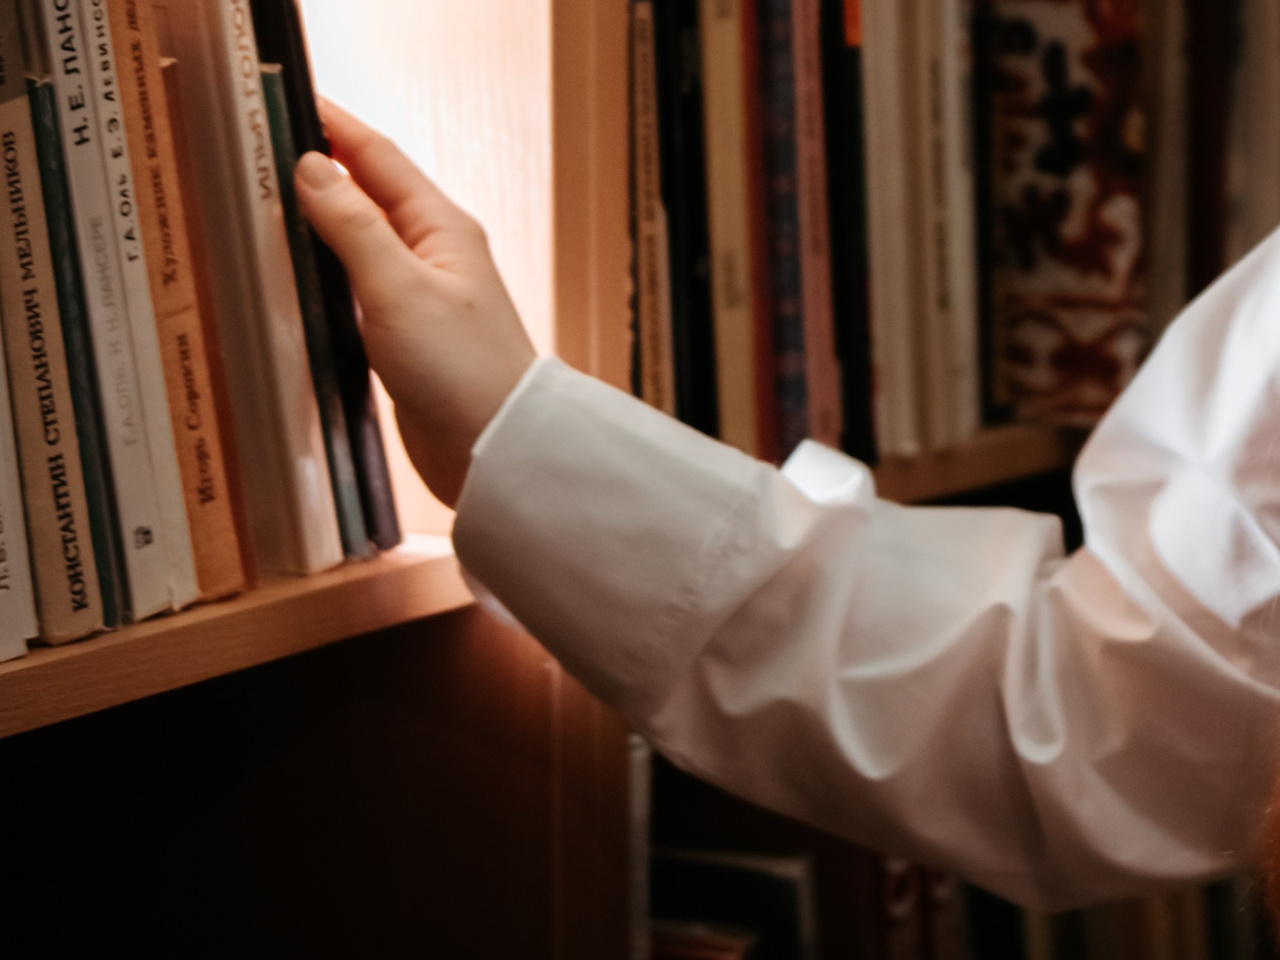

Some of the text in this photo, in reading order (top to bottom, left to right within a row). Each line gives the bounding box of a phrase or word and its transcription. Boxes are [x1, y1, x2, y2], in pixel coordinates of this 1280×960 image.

[70, 85, 90, 115] Е.
[3, 130, 90, 613] КОНСТАНТИН СТЕПАНОВИЧ МЕЛЬНИКОВ
